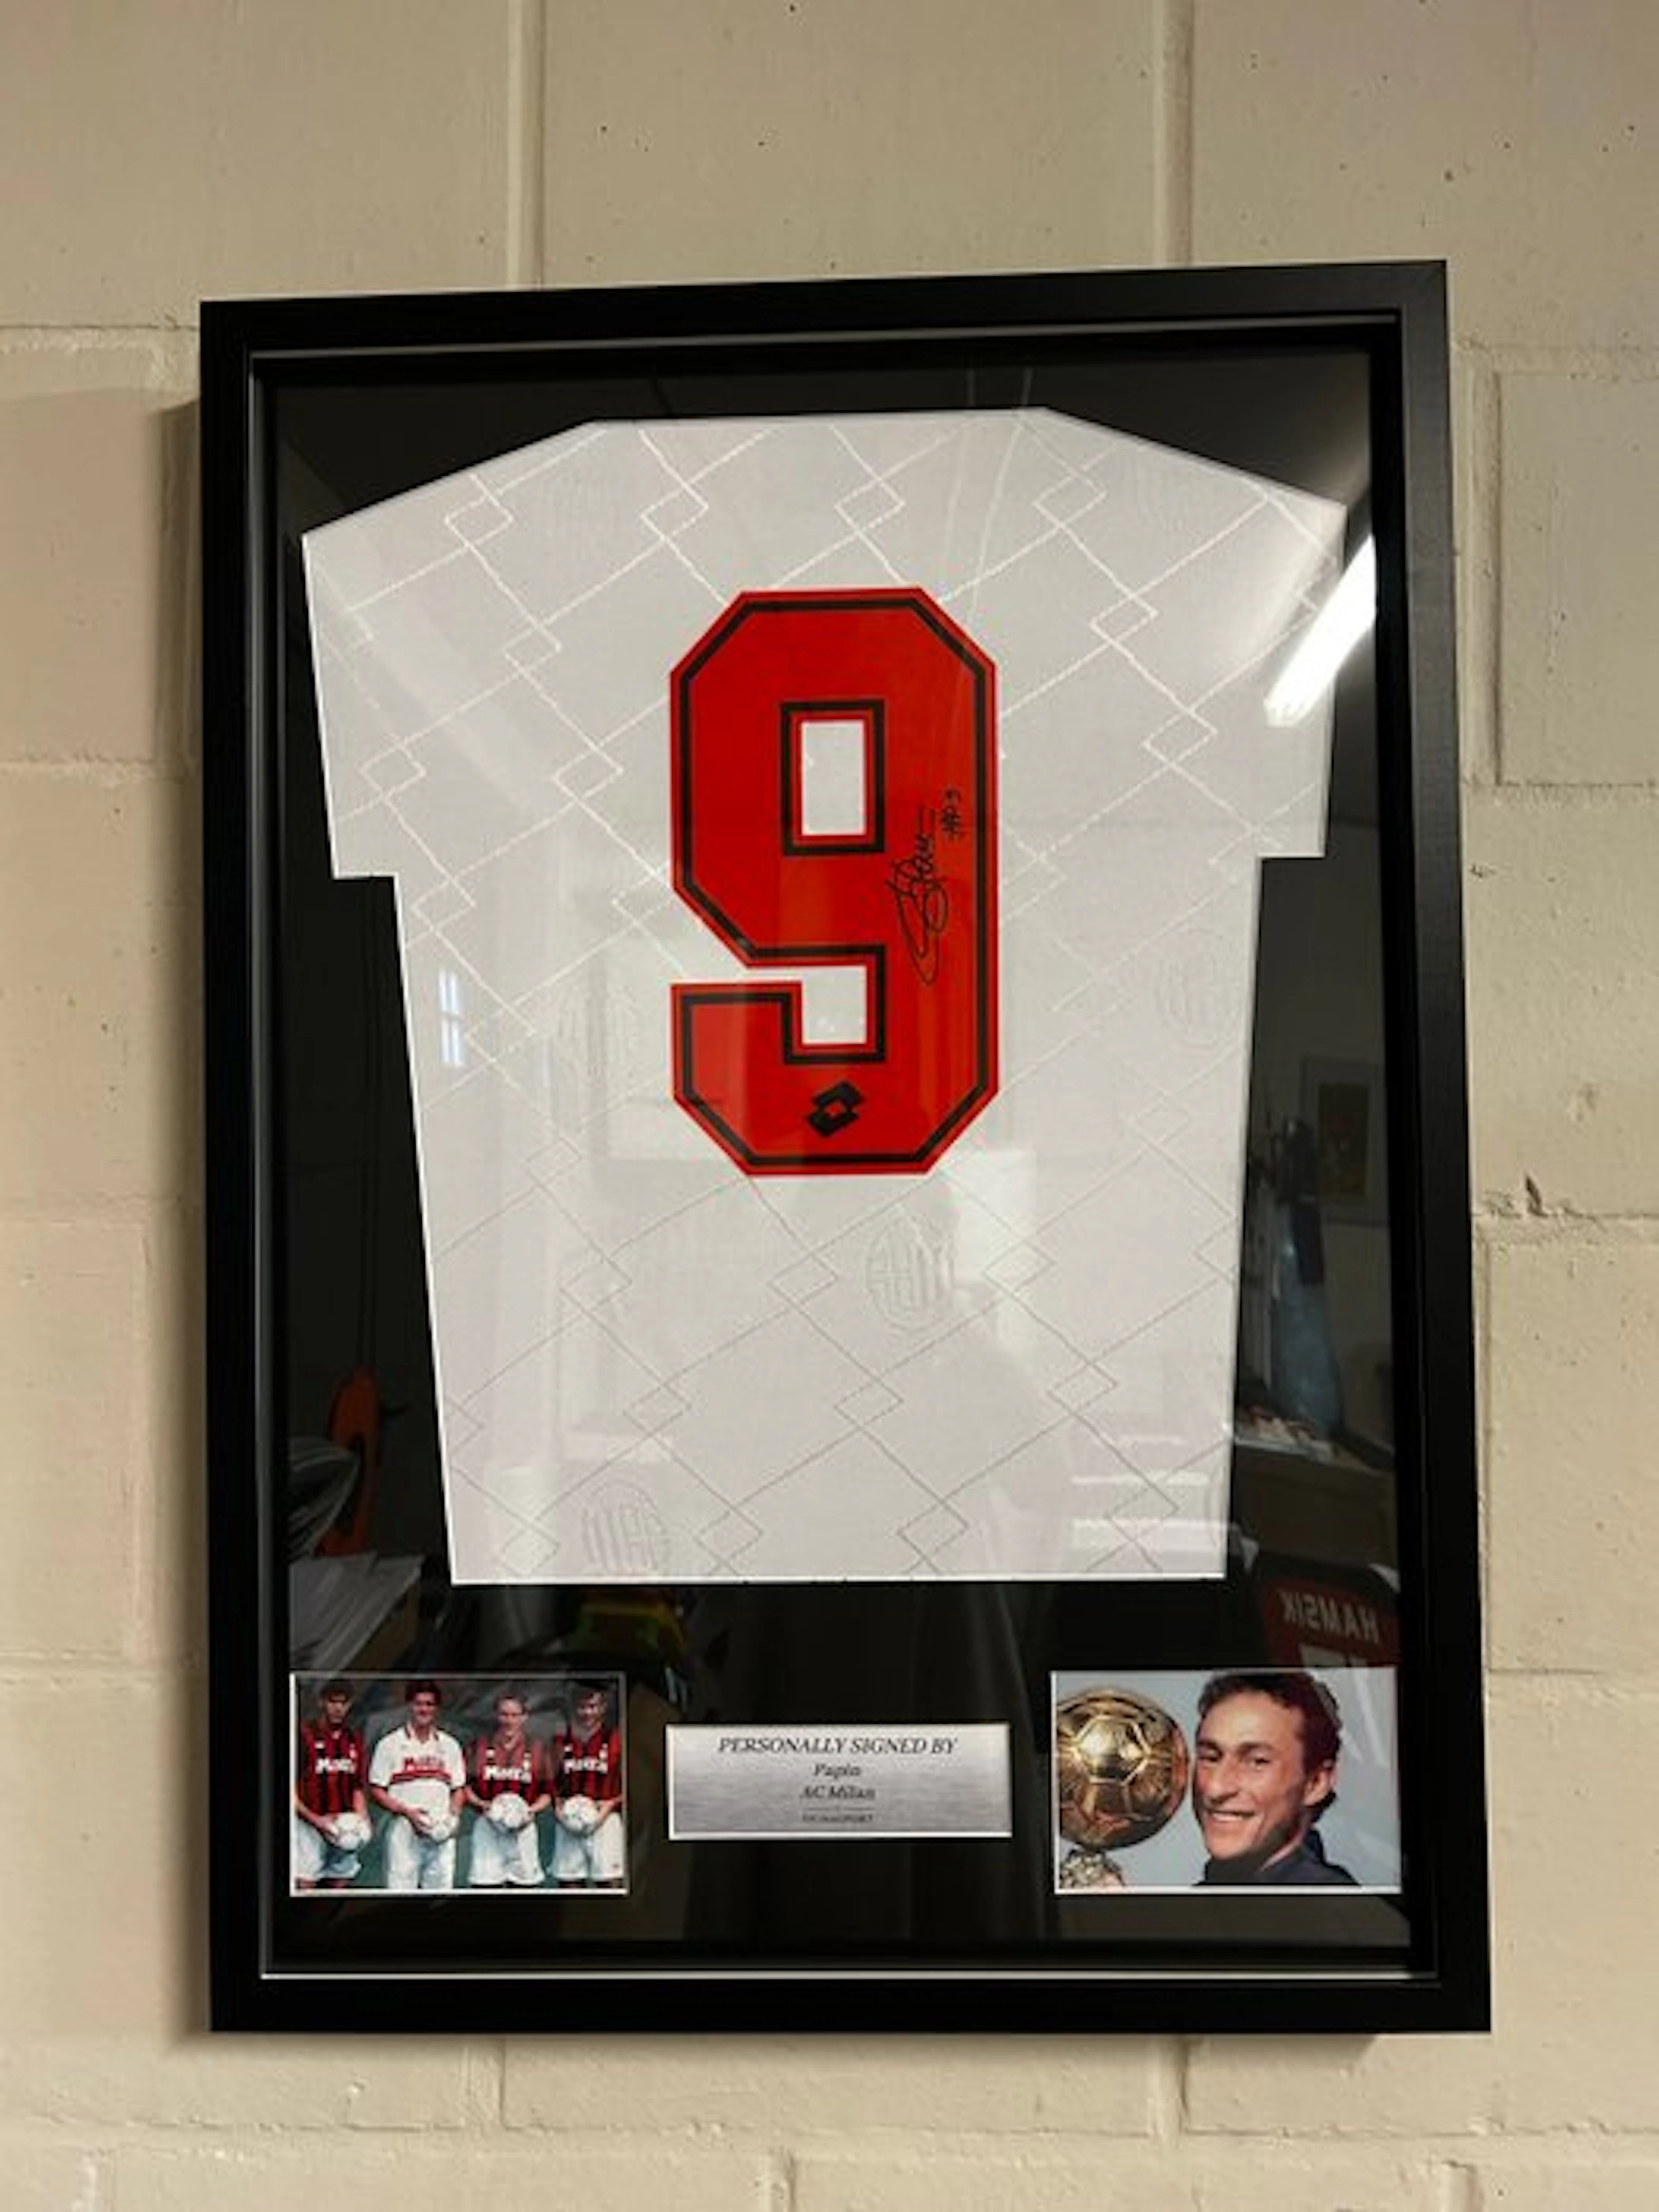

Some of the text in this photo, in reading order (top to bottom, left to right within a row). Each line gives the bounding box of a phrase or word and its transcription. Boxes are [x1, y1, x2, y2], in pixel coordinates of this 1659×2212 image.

[671, 587, 998, 1176] 9
[718, 1737, 958, 1754] PERSONALLY SIGNED BY
[800, 1785, 875, 1799] AC Milan
